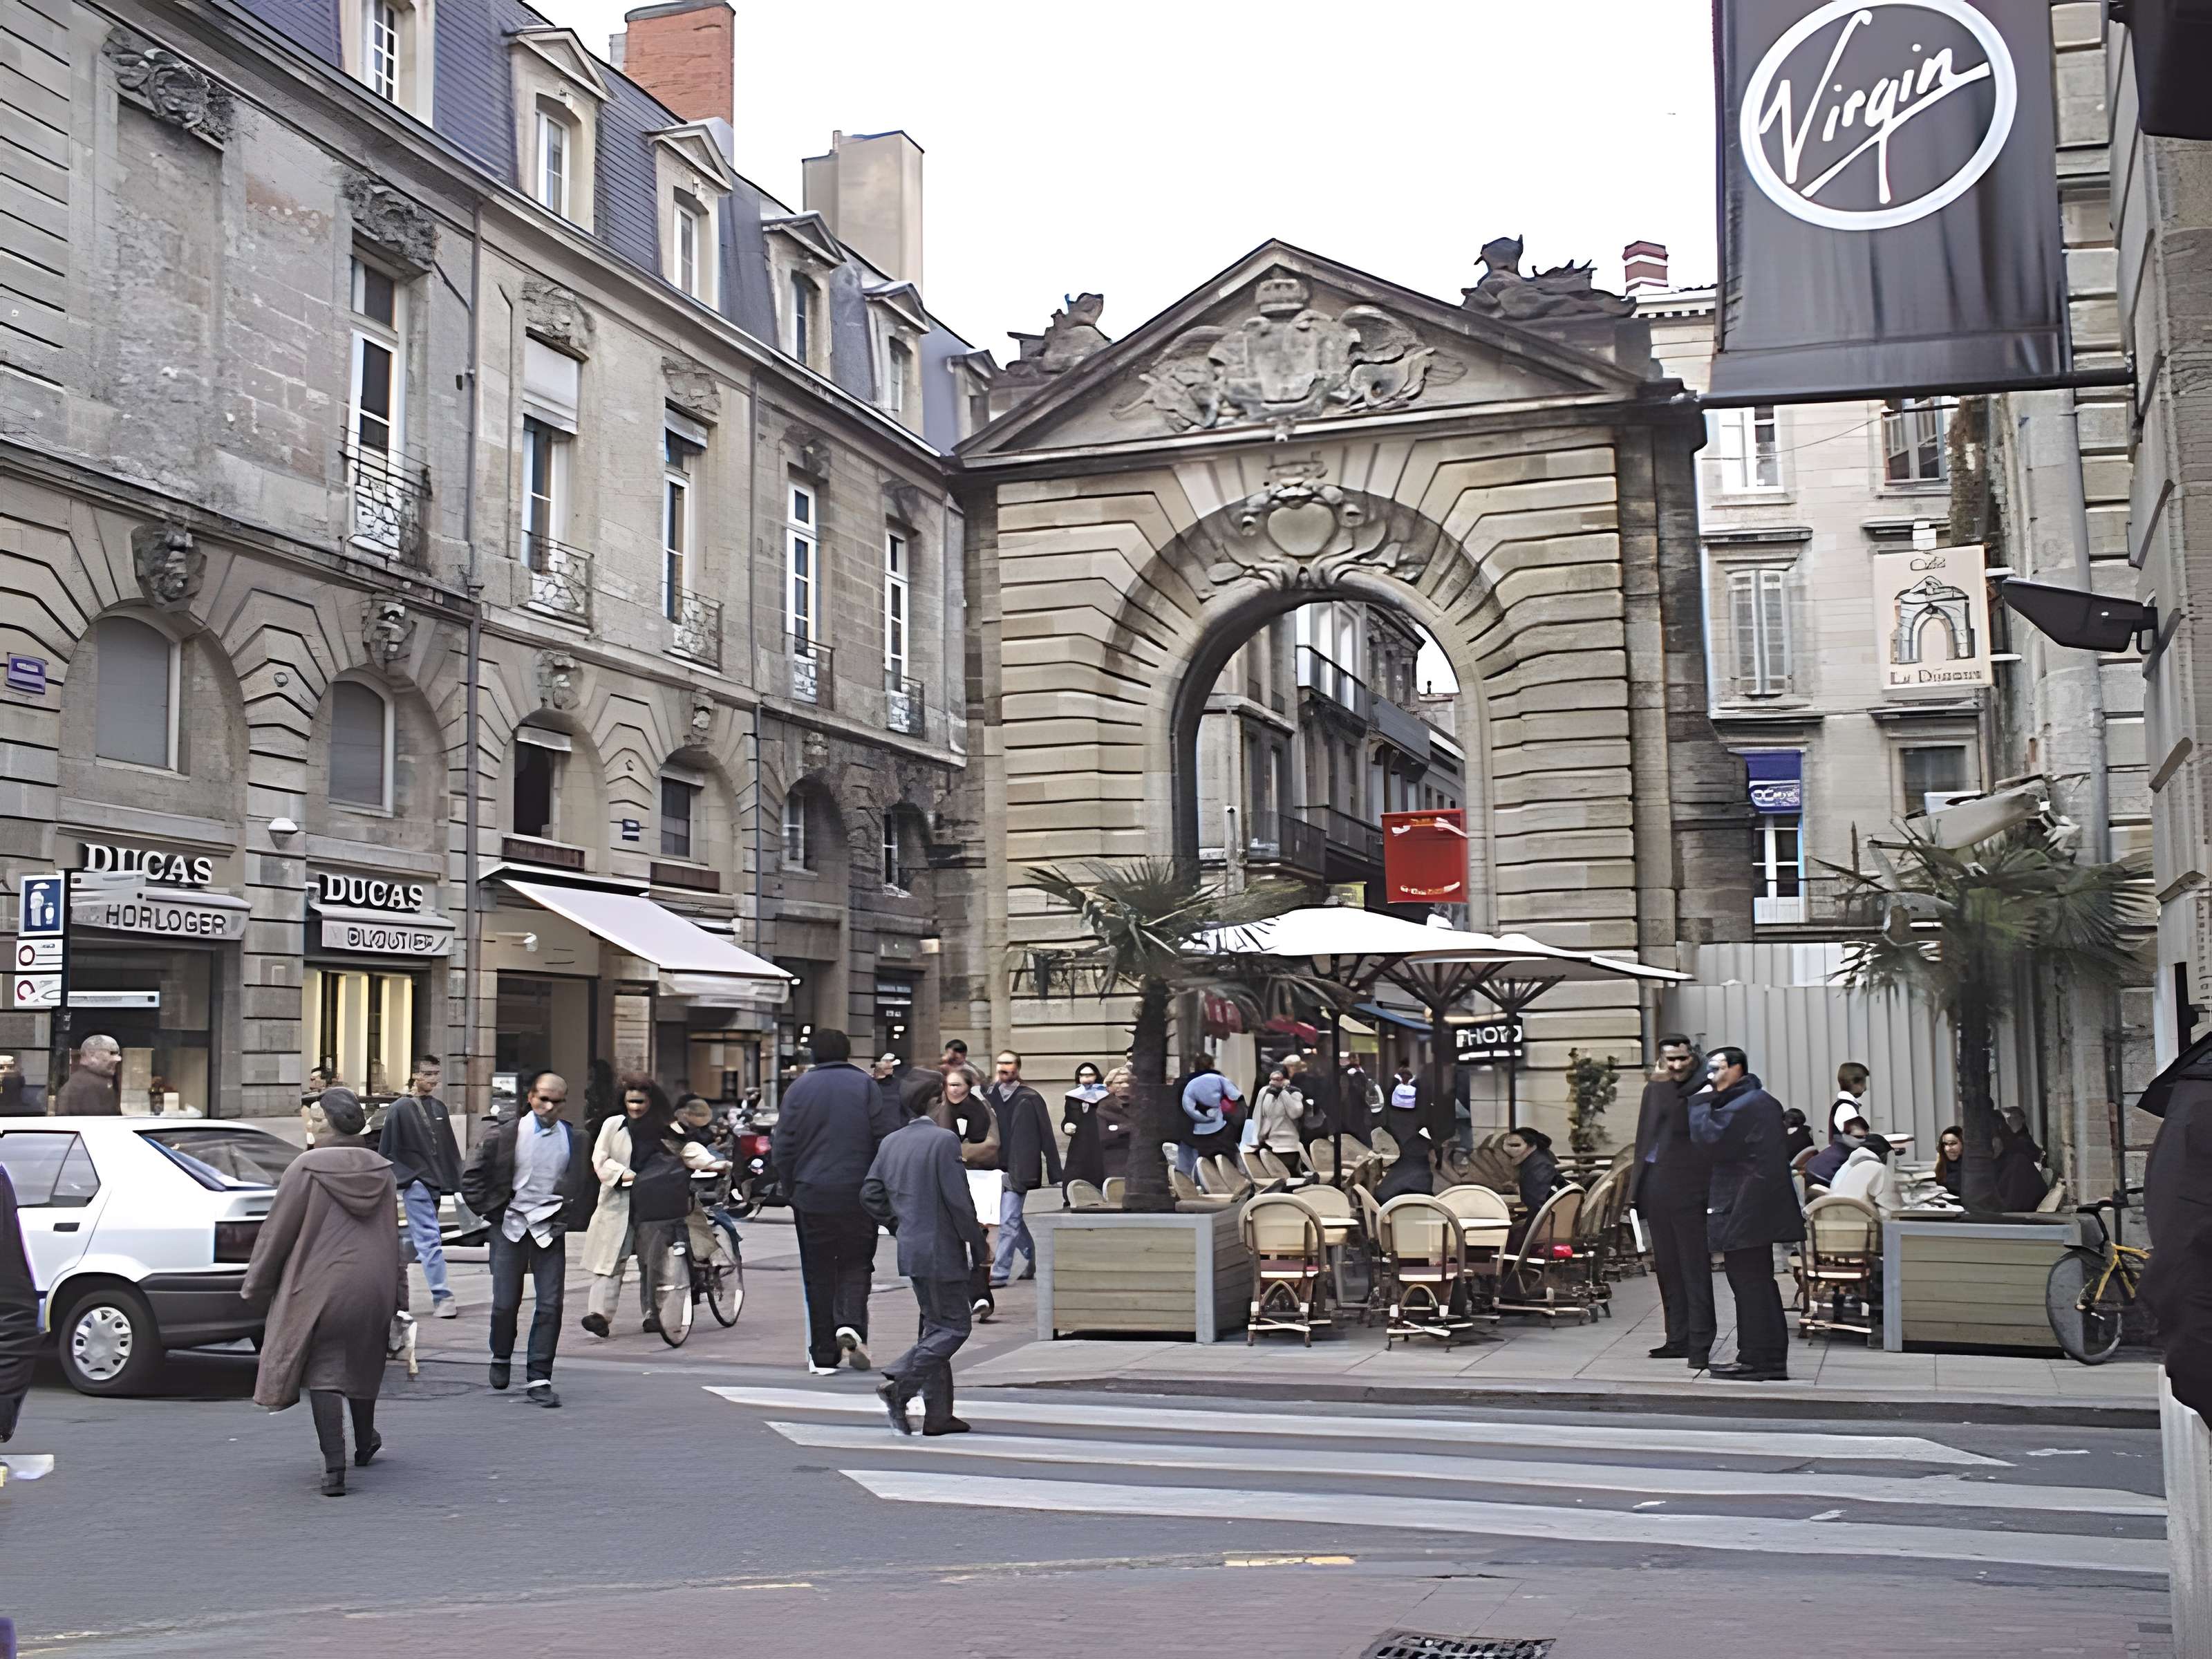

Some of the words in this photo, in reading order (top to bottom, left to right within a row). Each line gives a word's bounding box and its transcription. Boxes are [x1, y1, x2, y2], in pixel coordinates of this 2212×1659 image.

[1758, 9, 1991, 205] Virgin
[84, 843, 213, 885] DUCAS
[324, 874, 424, 911] DUCAS
[106, 903, 227, 935] HORLOGER
